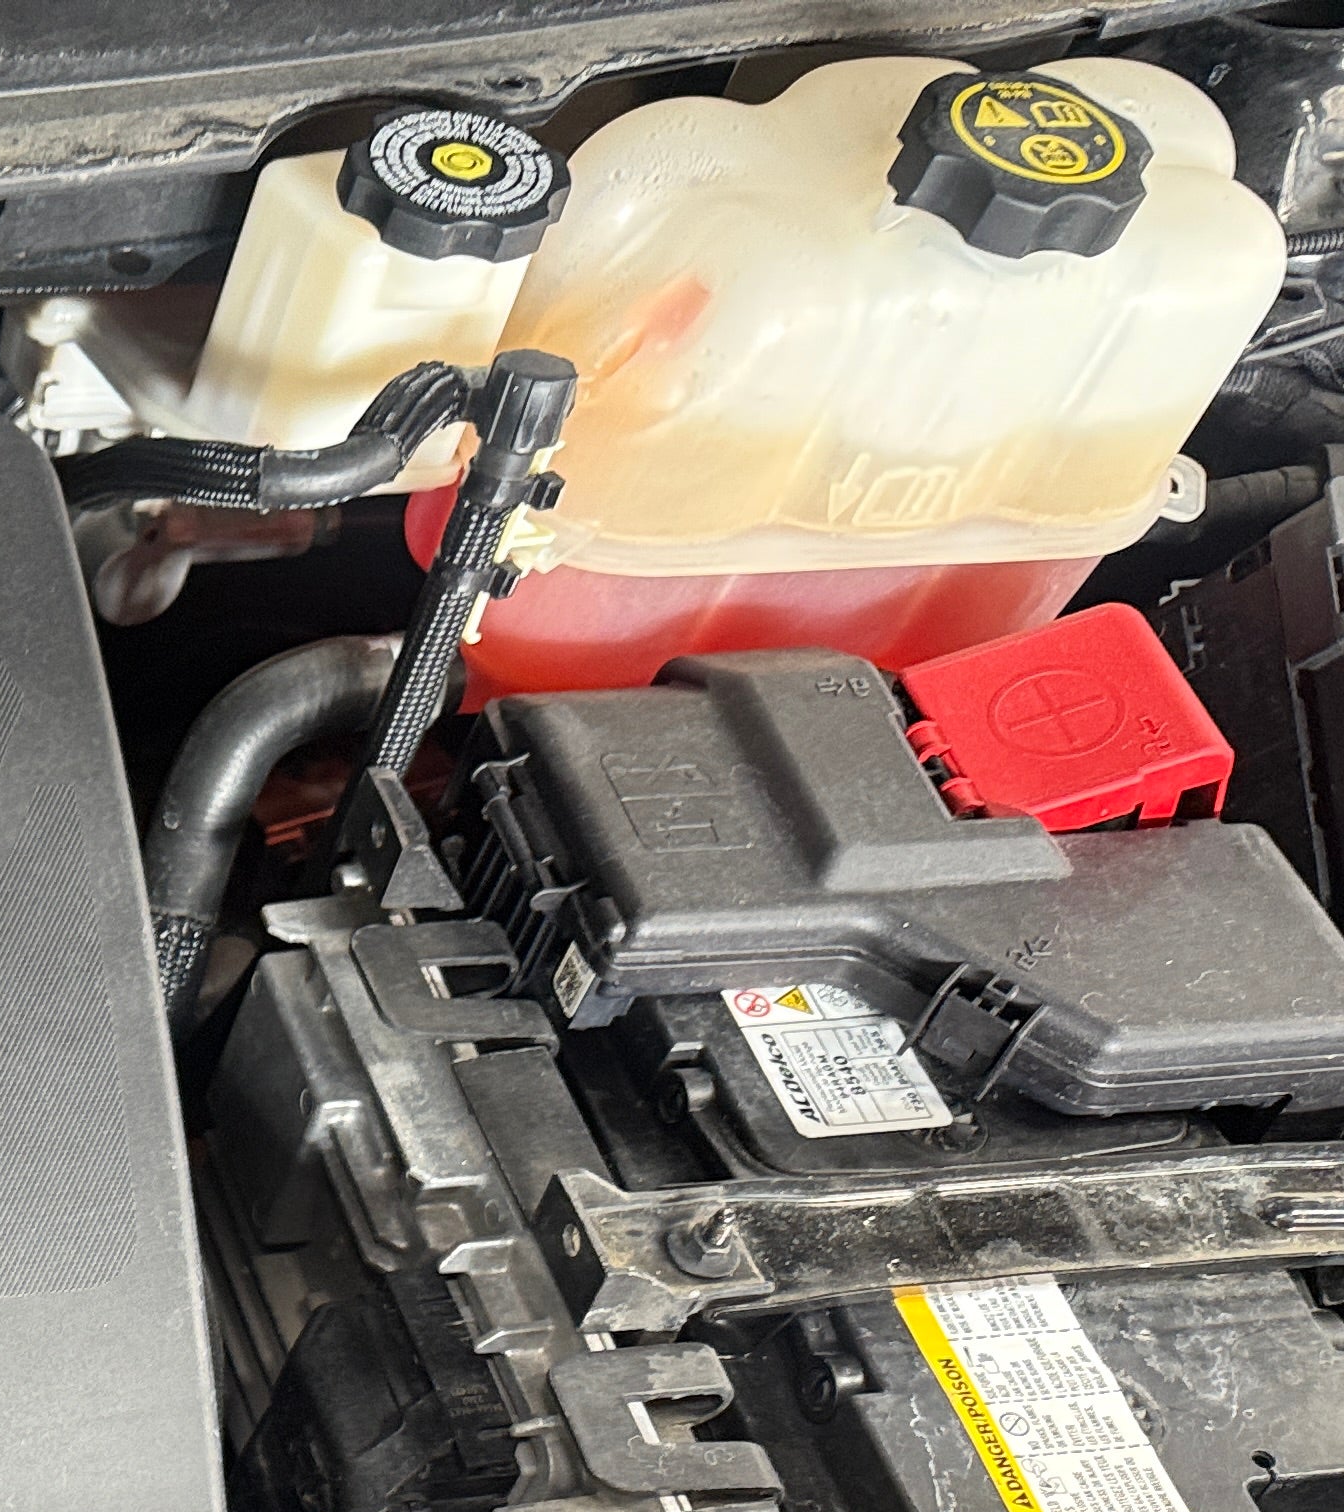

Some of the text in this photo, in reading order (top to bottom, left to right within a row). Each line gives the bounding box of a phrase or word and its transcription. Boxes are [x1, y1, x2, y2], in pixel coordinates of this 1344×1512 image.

[754, 1032, 822, 1124] ACDelco
[830, 1055, 867, 1095] 8540
[936, 1356, 1025, 1491] DANGER/POISON
